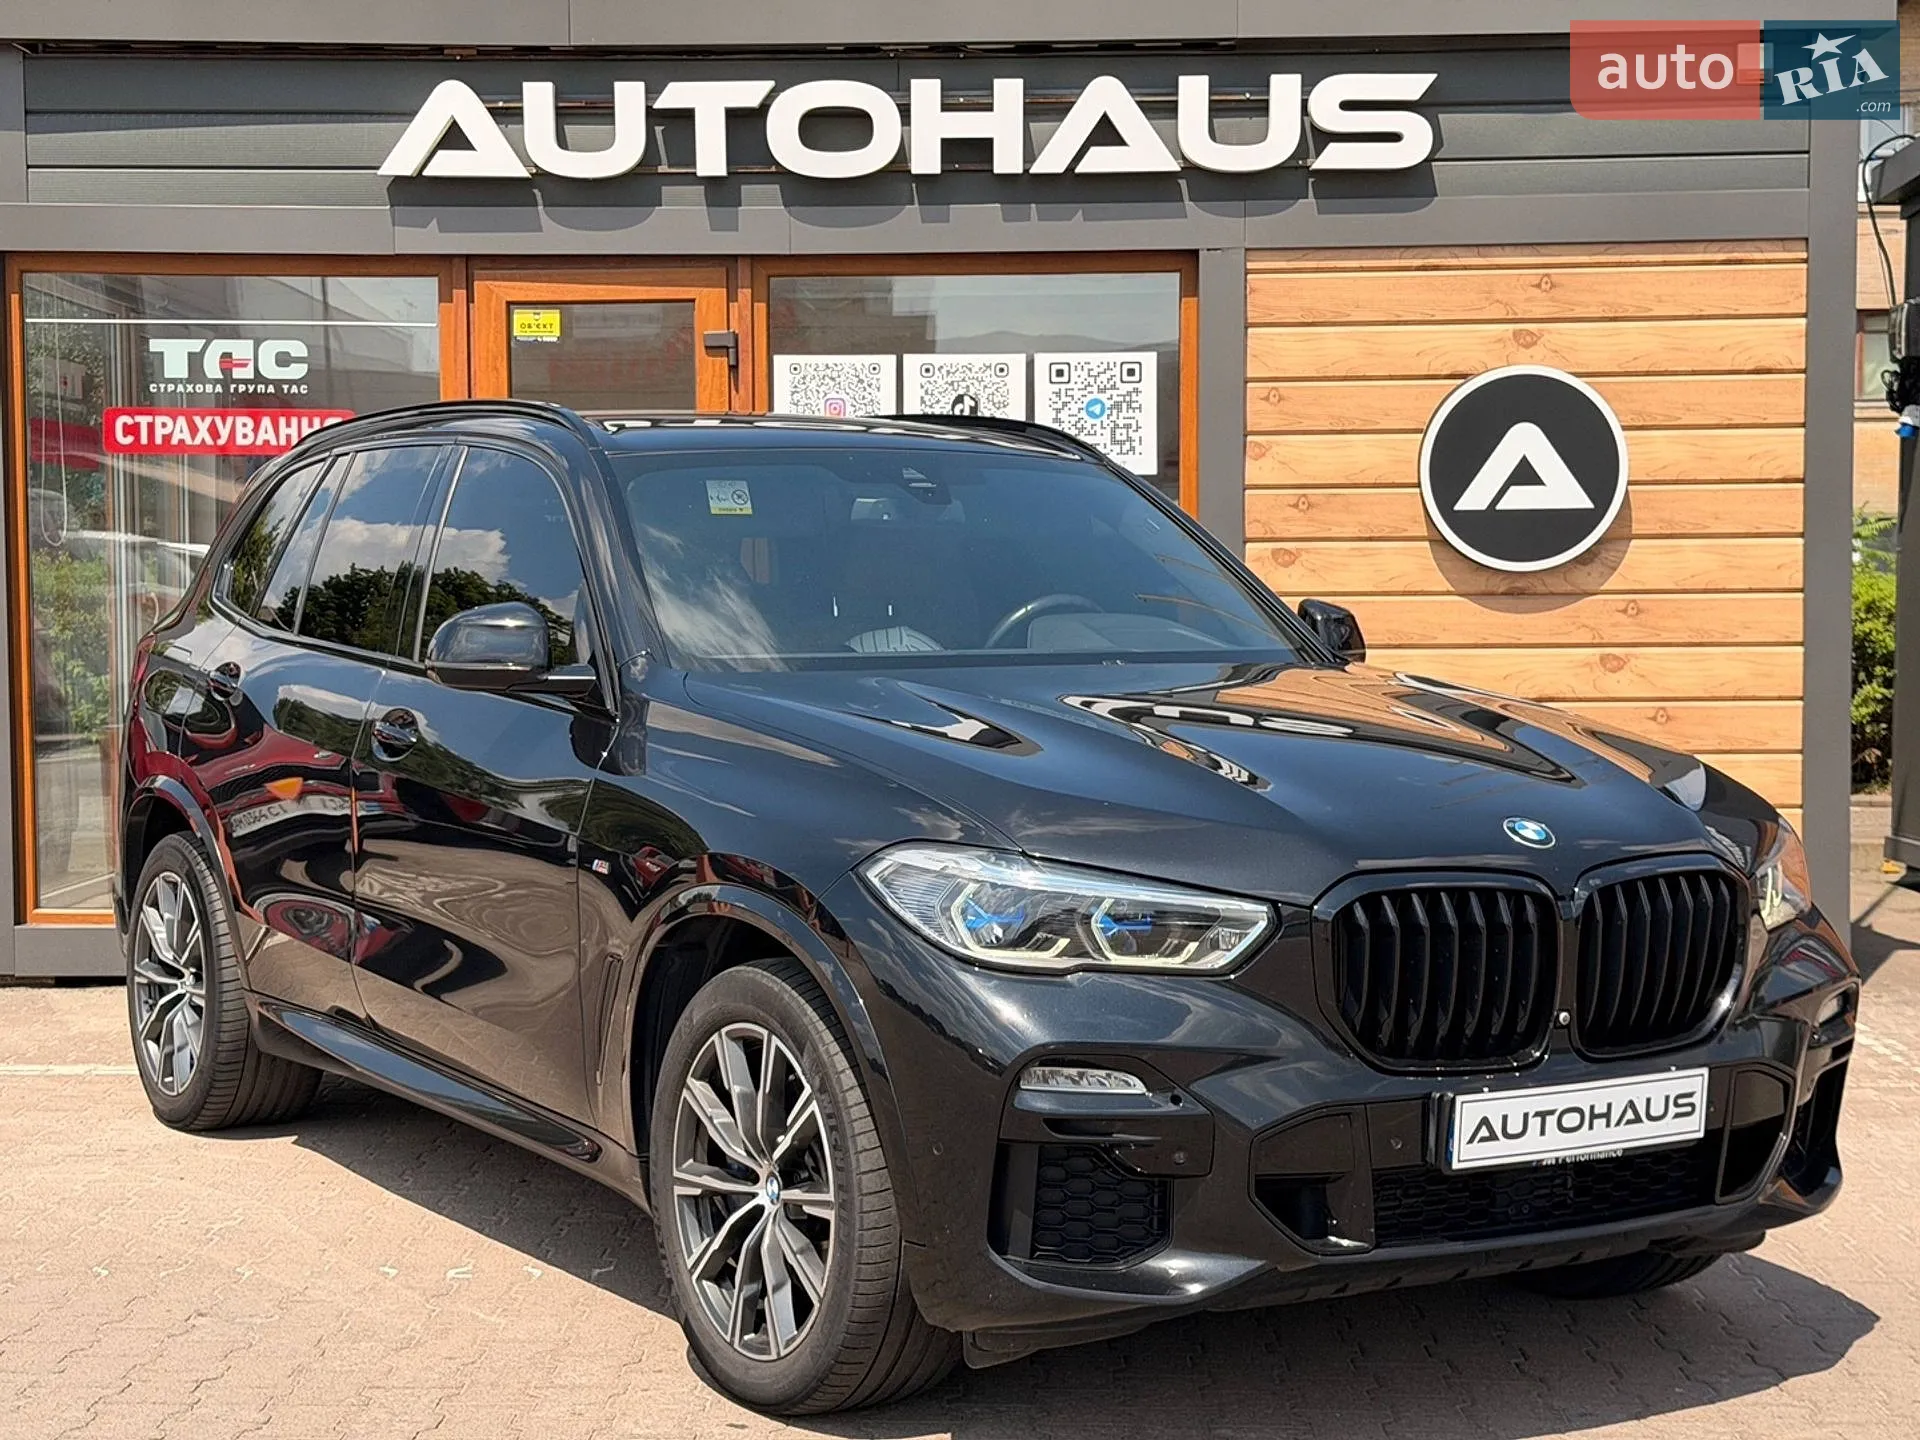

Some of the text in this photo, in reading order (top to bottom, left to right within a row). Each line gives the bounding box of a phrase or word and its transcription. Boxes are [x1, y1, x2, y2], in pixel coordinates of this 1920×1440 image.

[377, 73, 1438, 180] AUTOHAUS
[149, 383, 309, 395] СТРАХОВА ГРУПА ТАС
[114, 415, 344, 447] СТРАХУВАНН
[1466, 1090, 1697, 1145] AUTOHAUS
